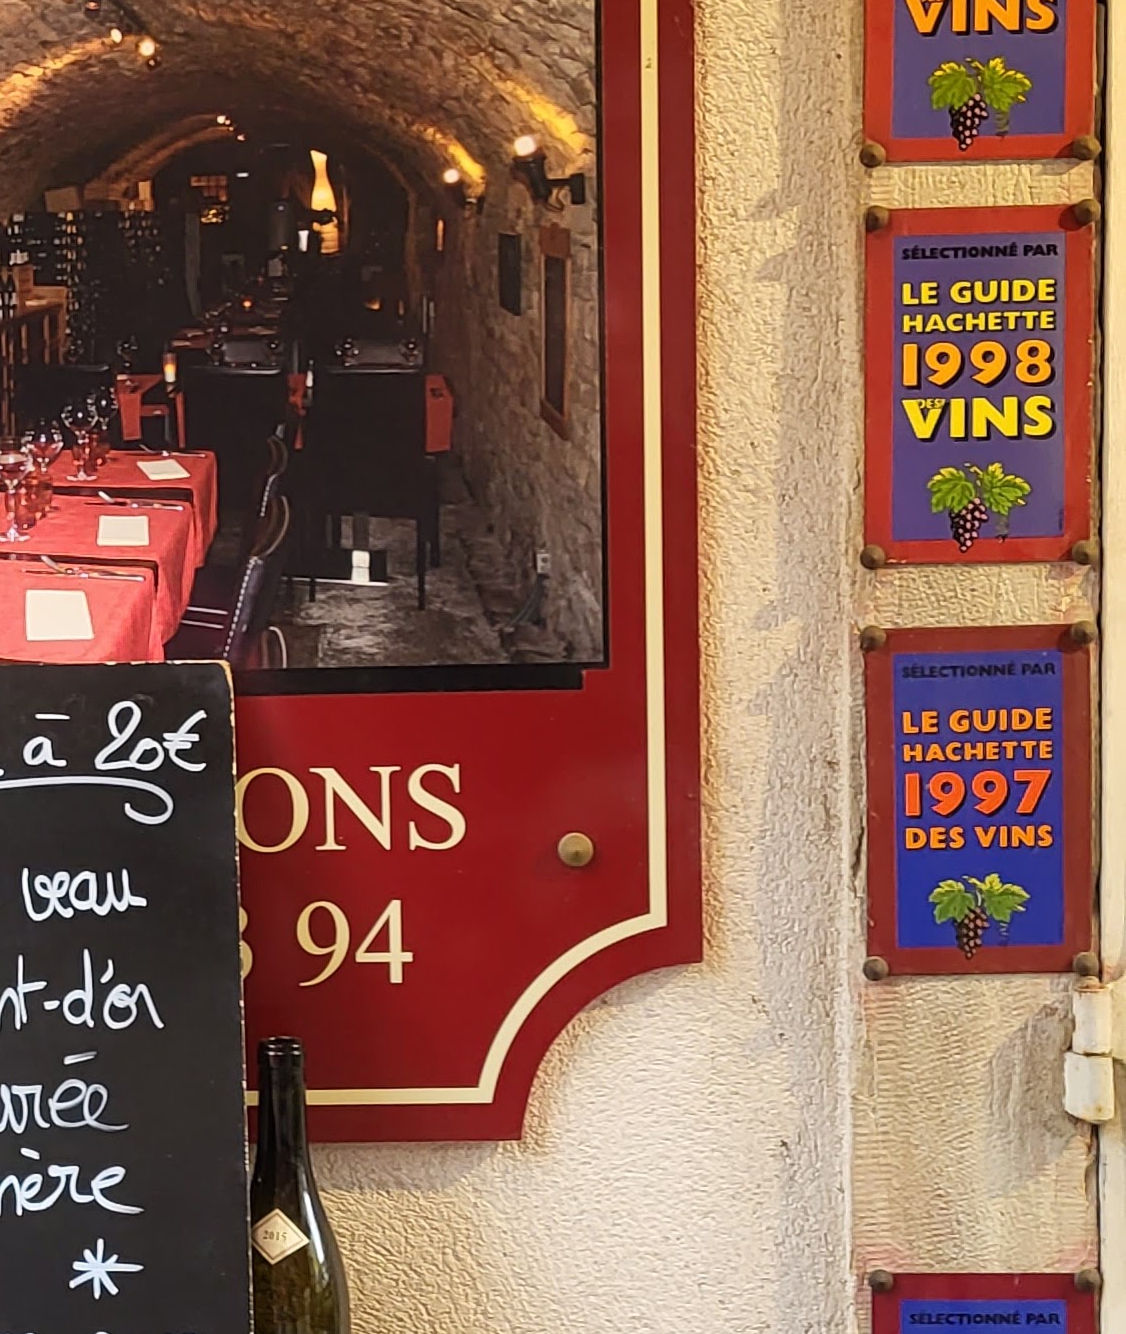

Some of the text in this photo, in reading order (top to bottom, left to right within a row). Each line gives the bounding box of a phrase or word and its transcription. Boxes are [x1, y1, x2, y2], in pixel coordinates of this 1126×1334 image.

[902, 243, 1058, 260] SÉLECTIONNÉ PAR
[901, 279, 1056, 306] LE GUIDE
[902, 311, 1056, 334] HACHETTE
[902, 340, 1055, 388] 1998
[901, 396, 1056, 441] DES VINS
[902, 661, 1055, 679] SÉLECTIONNÉ PAR
[902, 708, 1053, 734] LE GUIDE
[95, 699, 206, 773] 20€
[903, 740, 1053, 762] HACHETTE
[905, 770, 1051, 817] 1997
[905, 825, 1054, 850] DES VINS
[23, 865, 147, 918] veau
[297, 900, 414, 986] 94
[263, 1230, 287, 1242] 2015
[909, 1311, 1060, 1325] SÉLECTIONNÉ PAR
